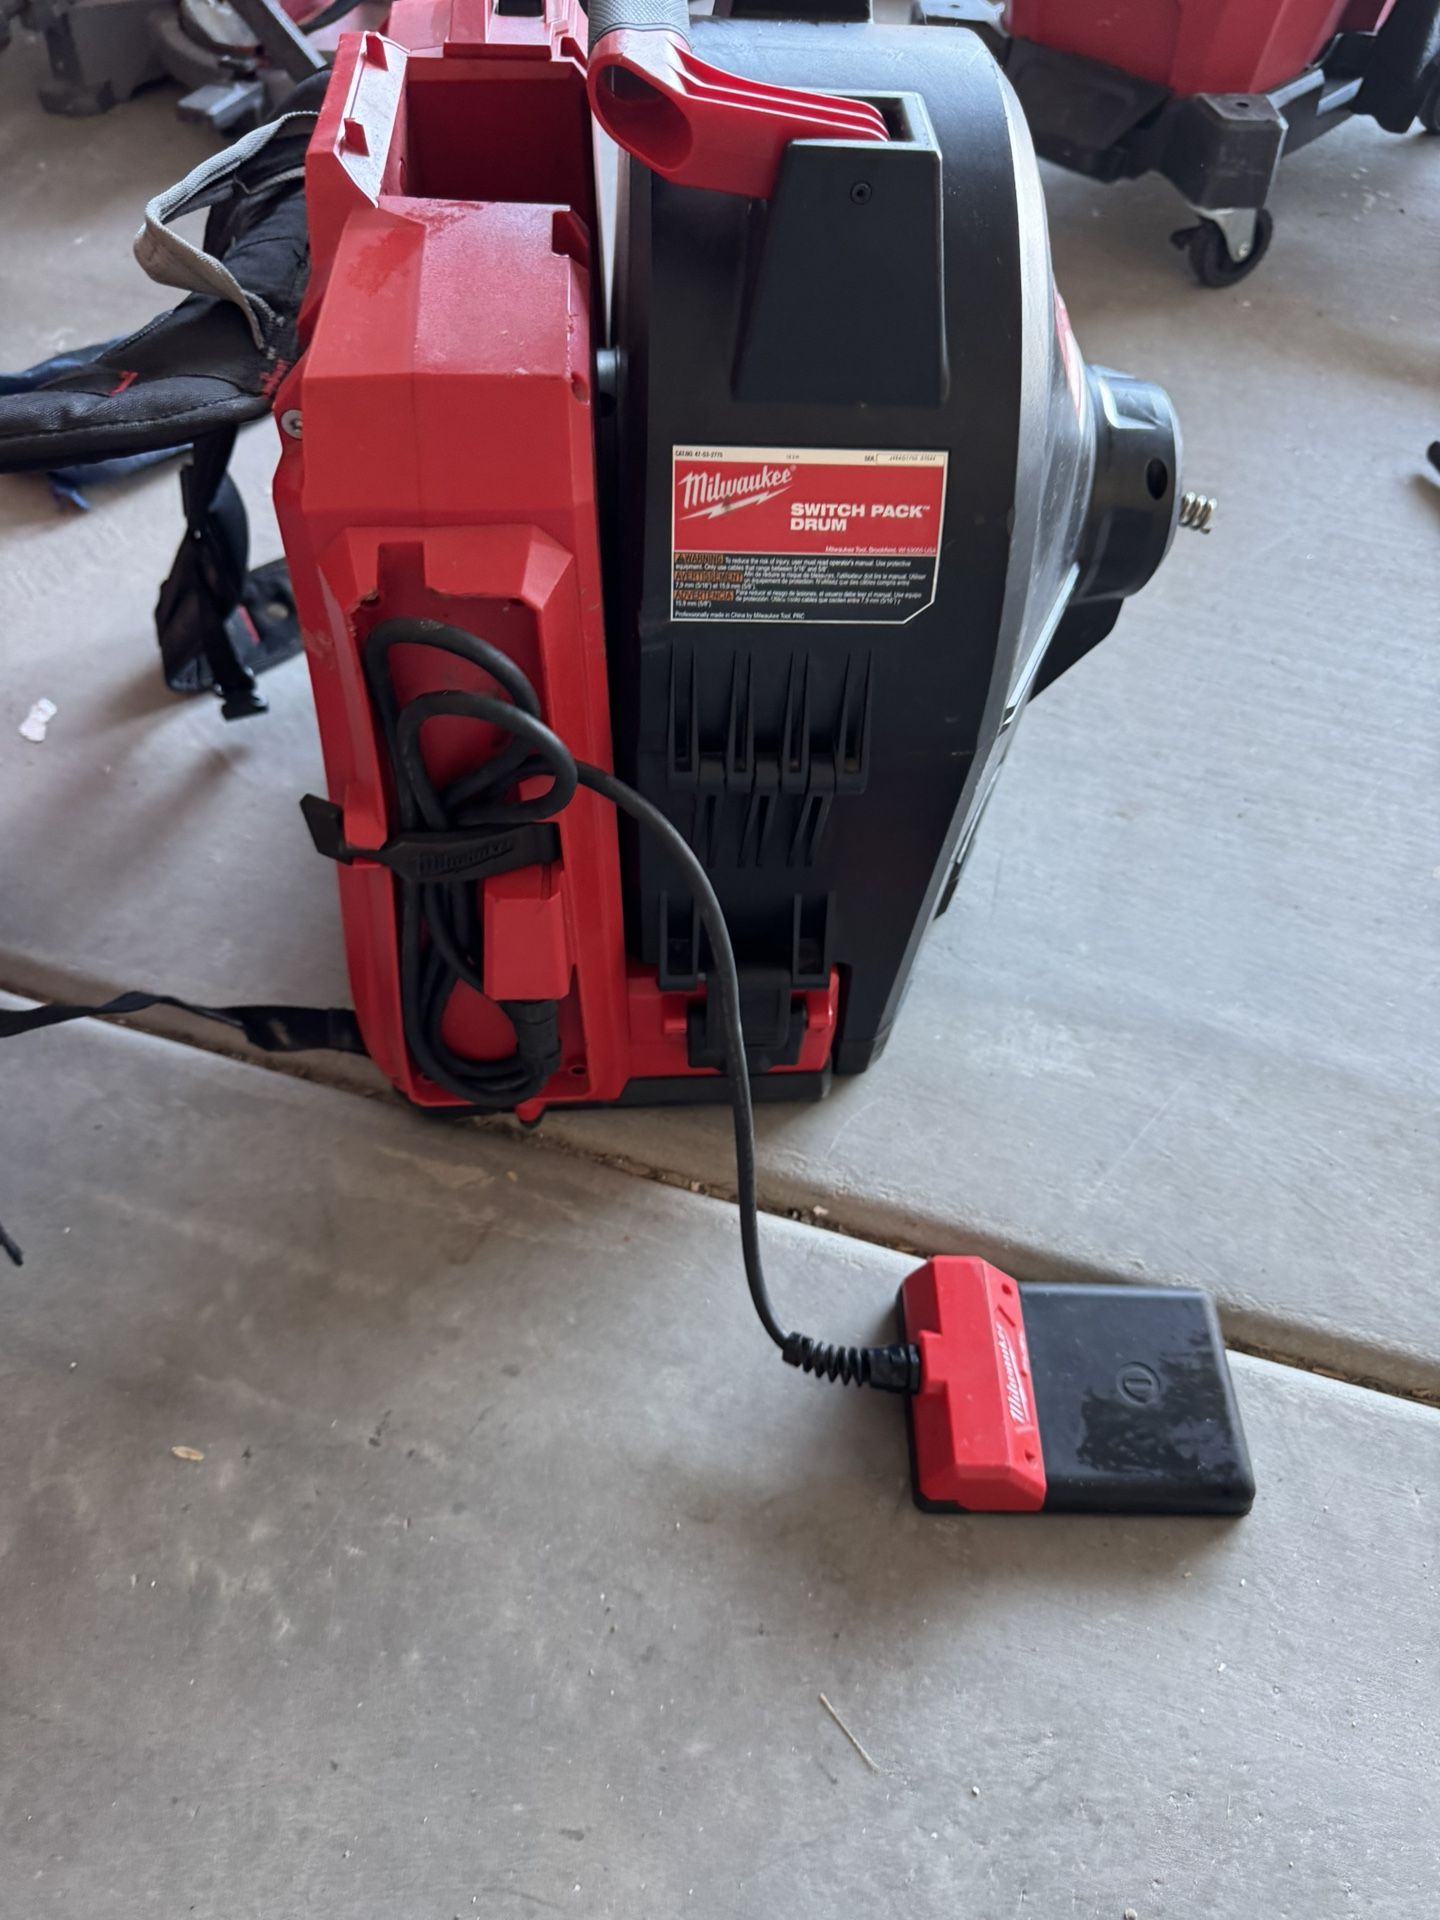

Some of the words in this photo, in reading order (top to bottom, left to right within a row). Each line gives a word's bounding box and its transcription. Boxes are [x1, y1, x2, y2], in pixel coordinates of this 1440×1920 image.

[678, 465, 793, 509] Milwaukee
[790, 502, 866, 518] SWITCH
[790, 518, 848, 532] DRUM
